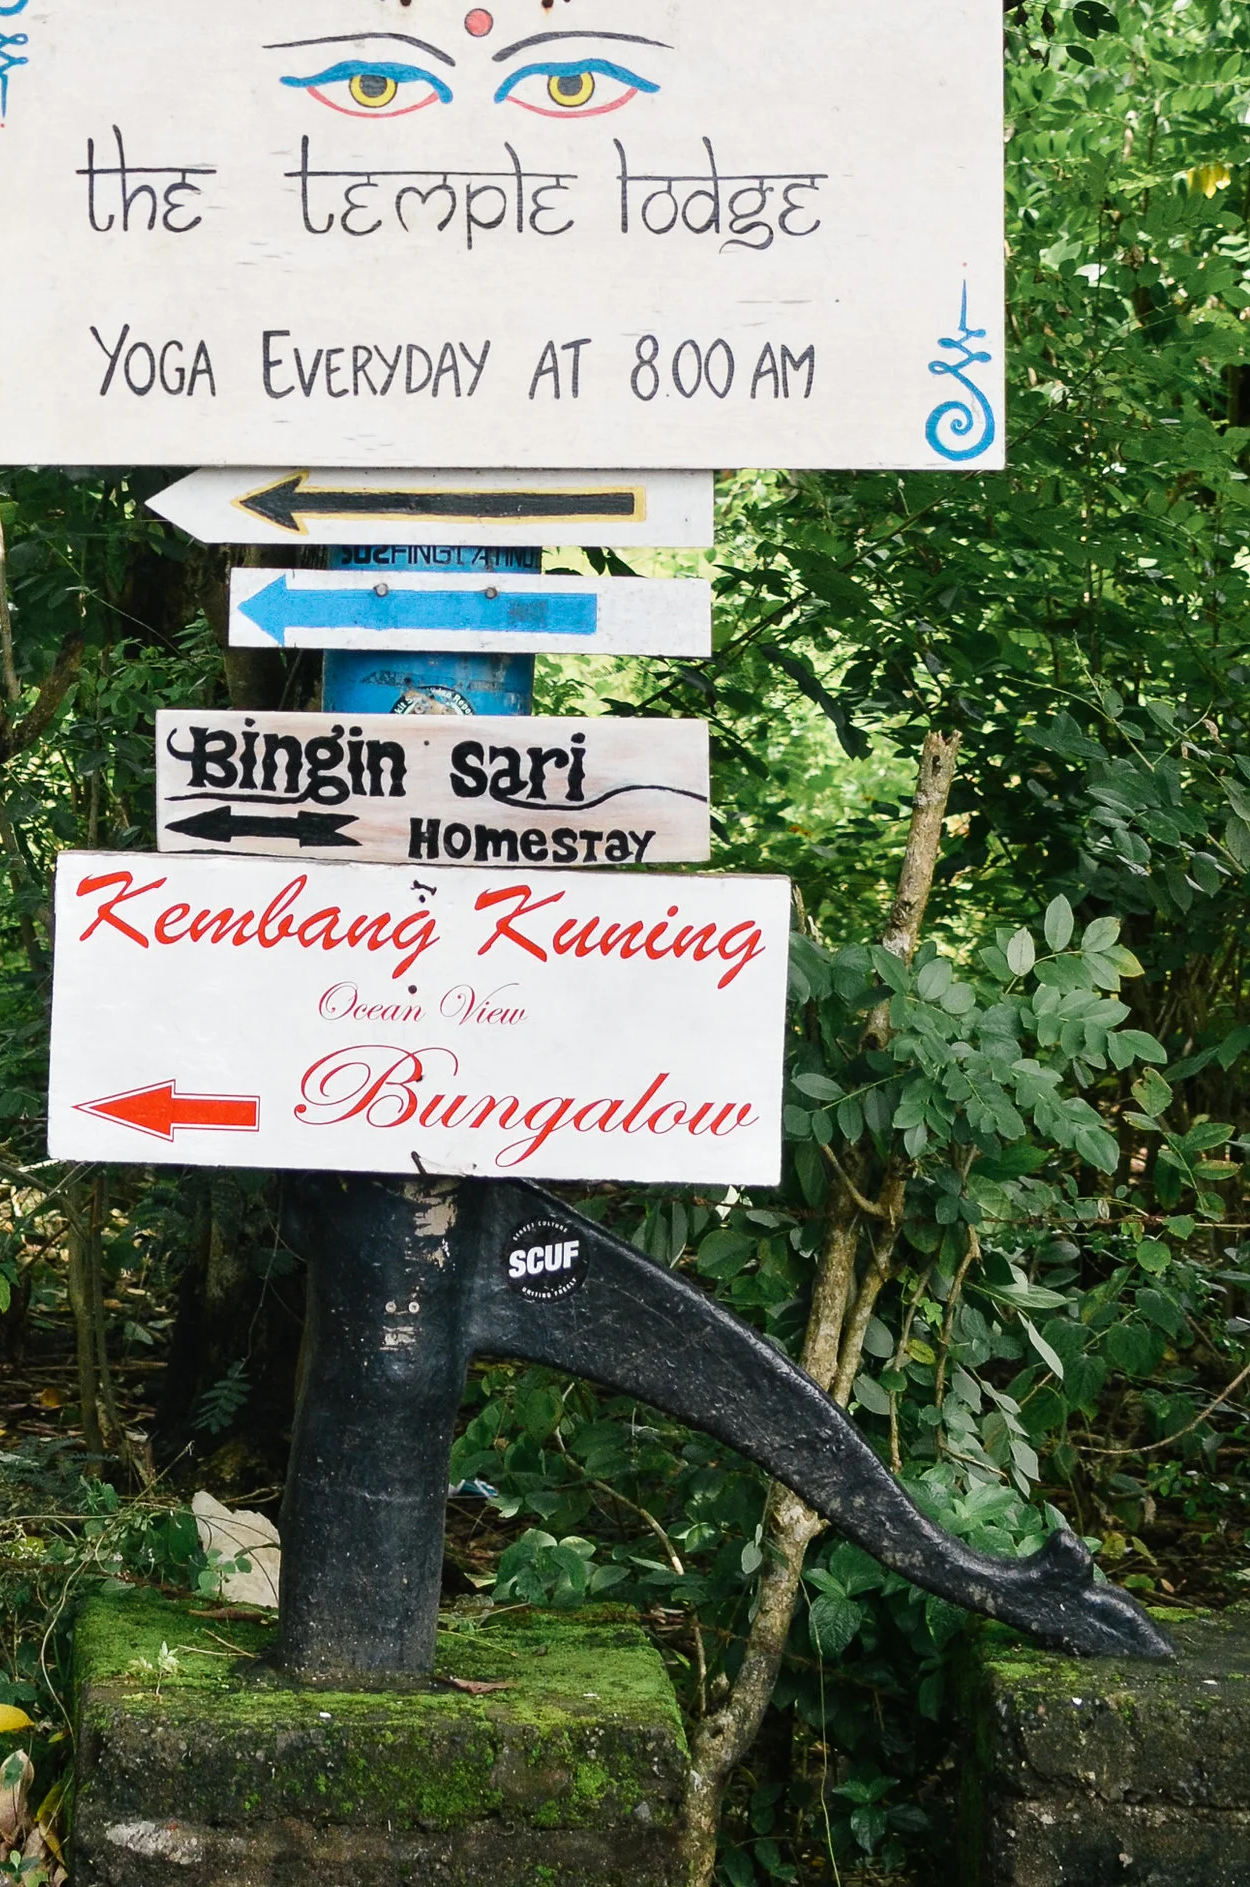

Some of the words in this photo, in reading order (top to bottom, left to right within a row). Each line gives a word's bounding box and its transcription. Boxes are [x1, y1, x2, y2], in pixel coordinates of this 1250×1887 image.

[76, 125, 217, 233] the
[285, 136, 578, 249] temple
[614, 137, 828, 254] lodge
[529, 338, 592, 400] AT
[750, 340, 816, 399] AM
[76, 870, 440, 978] Kembang
[475, 884, 766, 989] Kuning
[318, 980, 426, 1021] Ocean
[439, 982, 529, 1026] View
[293, 1044, 759, 1167] Bungalow
[508, 1240, 580, 1279] SCUF
